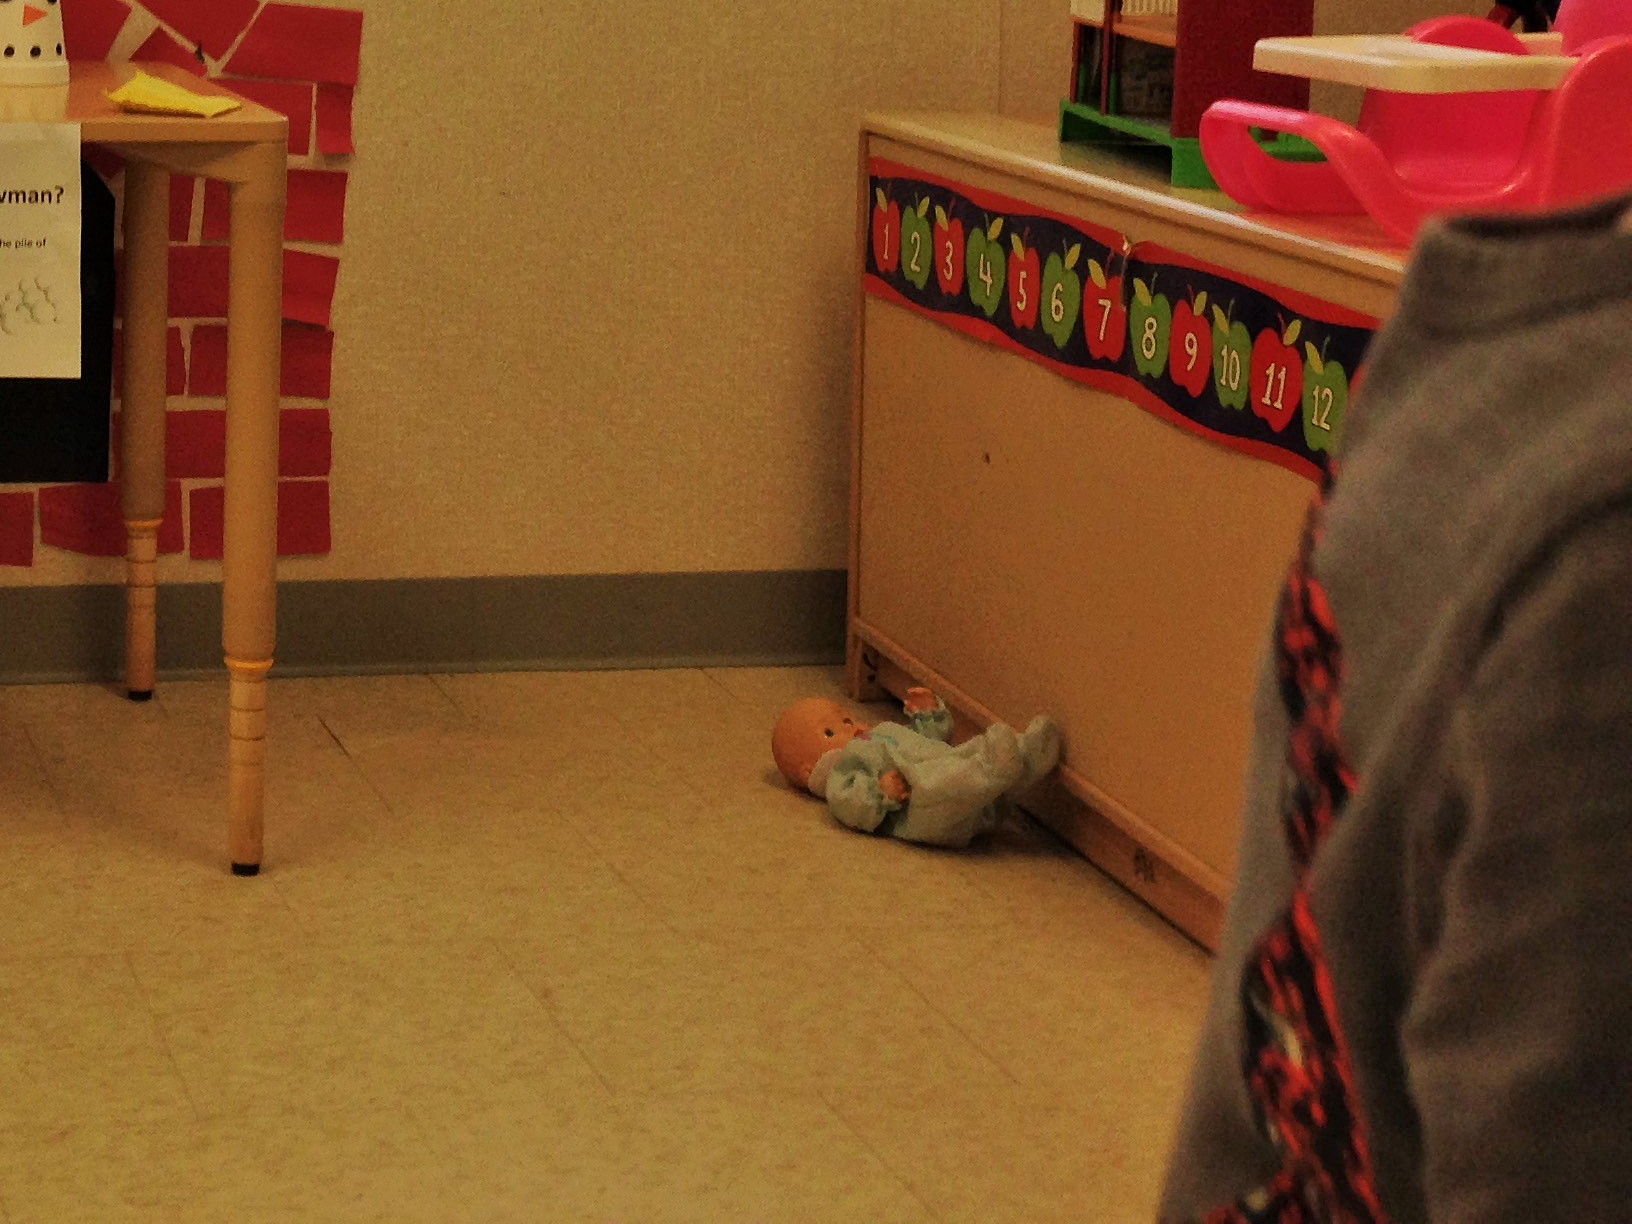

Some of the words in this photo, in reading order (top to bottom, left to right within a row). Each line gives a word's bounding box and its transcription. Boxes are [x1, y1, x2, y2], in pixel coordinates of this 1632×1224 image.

[14, 238, 33, 250] pile
[35, 237, 47, 249] of
[883, 223, 889, 260] 1
[910, 231, 921, 272] 2
[943, 240, 954, 281] 3
[979, 253, 993, 296] 4
[1017, 271, 1027, 311] 5
[1051, 283, 1064, 322] 6
[1098, 298, 1112, 341] 7
[1141, 316, 1157, 360] 8
[1184, 332, 1198, 372] 9
[1220, 344, 1241, 391] 10
[1261, 362, 1287, 410] 11
[1311, 385, 1333, 431] 12
